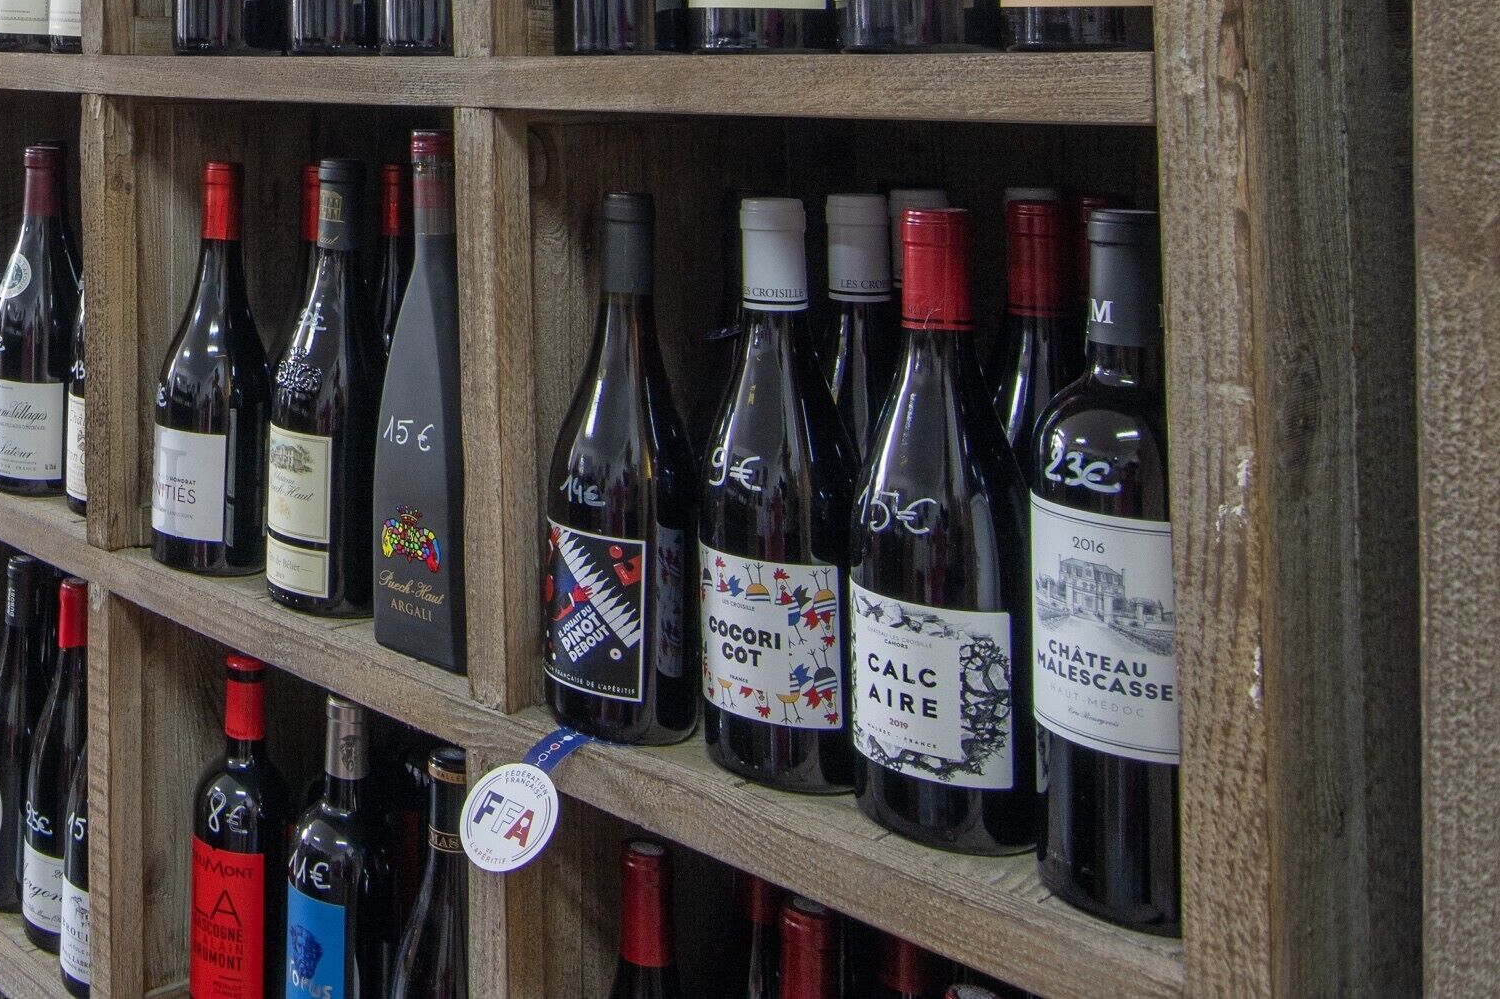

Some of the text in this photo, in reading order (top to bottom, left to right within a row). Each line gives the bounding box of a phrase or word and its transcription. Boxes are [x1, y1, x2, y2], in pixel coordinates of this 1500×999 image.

[1090, 298, 1114, 325] M
[1044, 447, 1122, 494] 23€
[559, 476, 606, 507] 14€
[858, 484, 938, 535] 15€
[1072, 535, 1106, 555] 2016
[390, 598, 433, 623] ARGALI
[561, 610, 603, 652] PINOT
[568, 622, 610, 664] DEBOUT
[708, 614, 782, 651] COCORI
[721, 641, 763, 668] COT
[867, 652, 939, 690] CALC
[1048, 638, 1148, 679] CHÂTEAU
[1037, 648, 1174, 703] MALESCASSE
[867, 682, 939, 719] AIRE
[888, 717, 909, 731] 2019
[505, 769, 549, 796] FÉDÉRATION
[505, 777, 543, 799] FRANÇAISE
[473, 790, 535, 848] FFA
[469, 841, 507, 865] L'APÉRITIF
